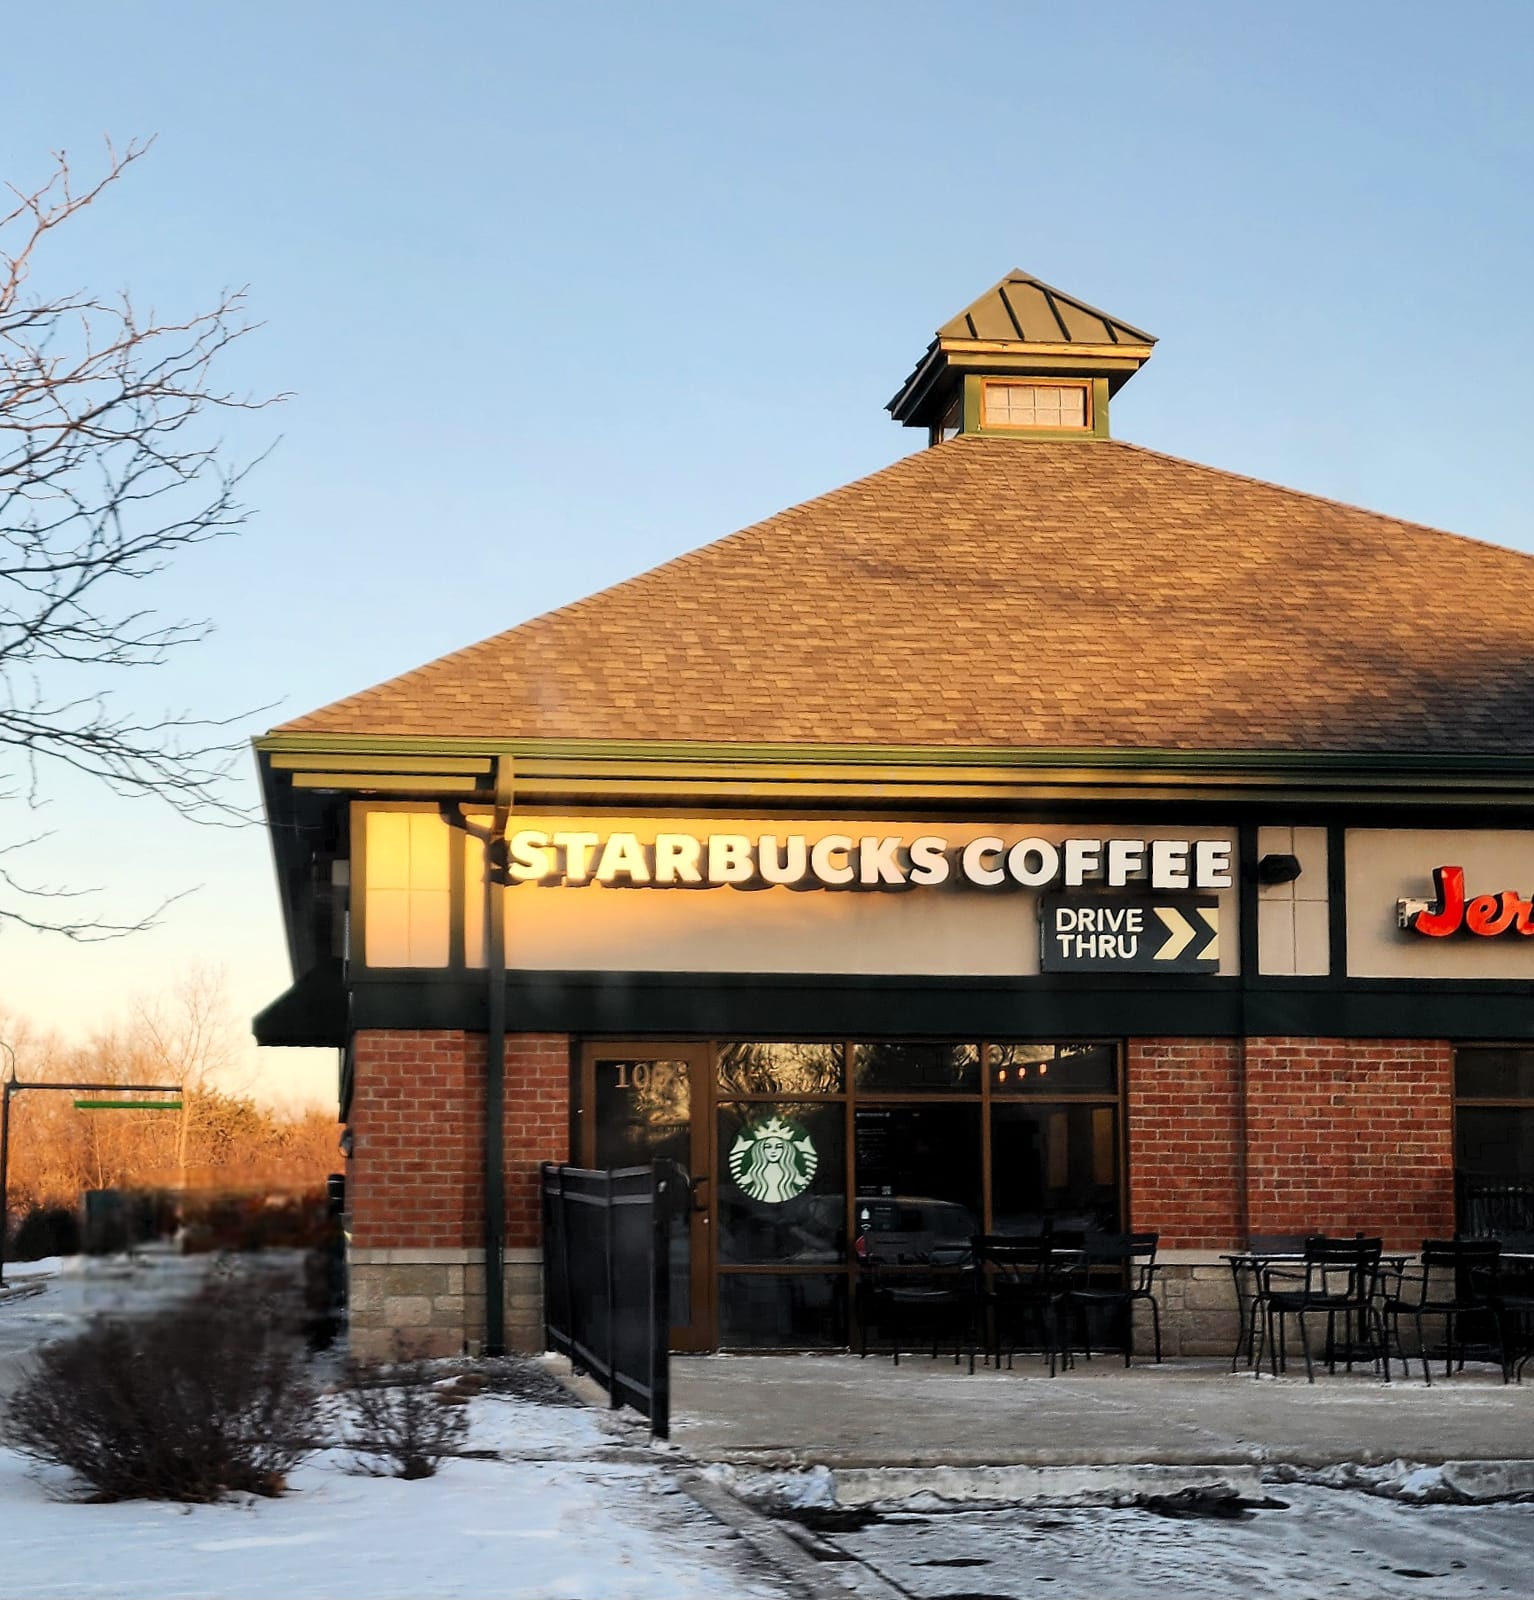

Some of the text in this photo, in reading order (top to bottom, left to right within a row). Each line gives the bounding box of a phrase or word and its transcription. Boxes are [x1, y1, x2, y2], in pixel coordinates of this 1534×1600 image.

[508, 830, 1232, 889] STARBUCKS COFFEE
[1055, 907, 1144, 933] DRIVE
[1055, 934, 1139, 960] THRU
